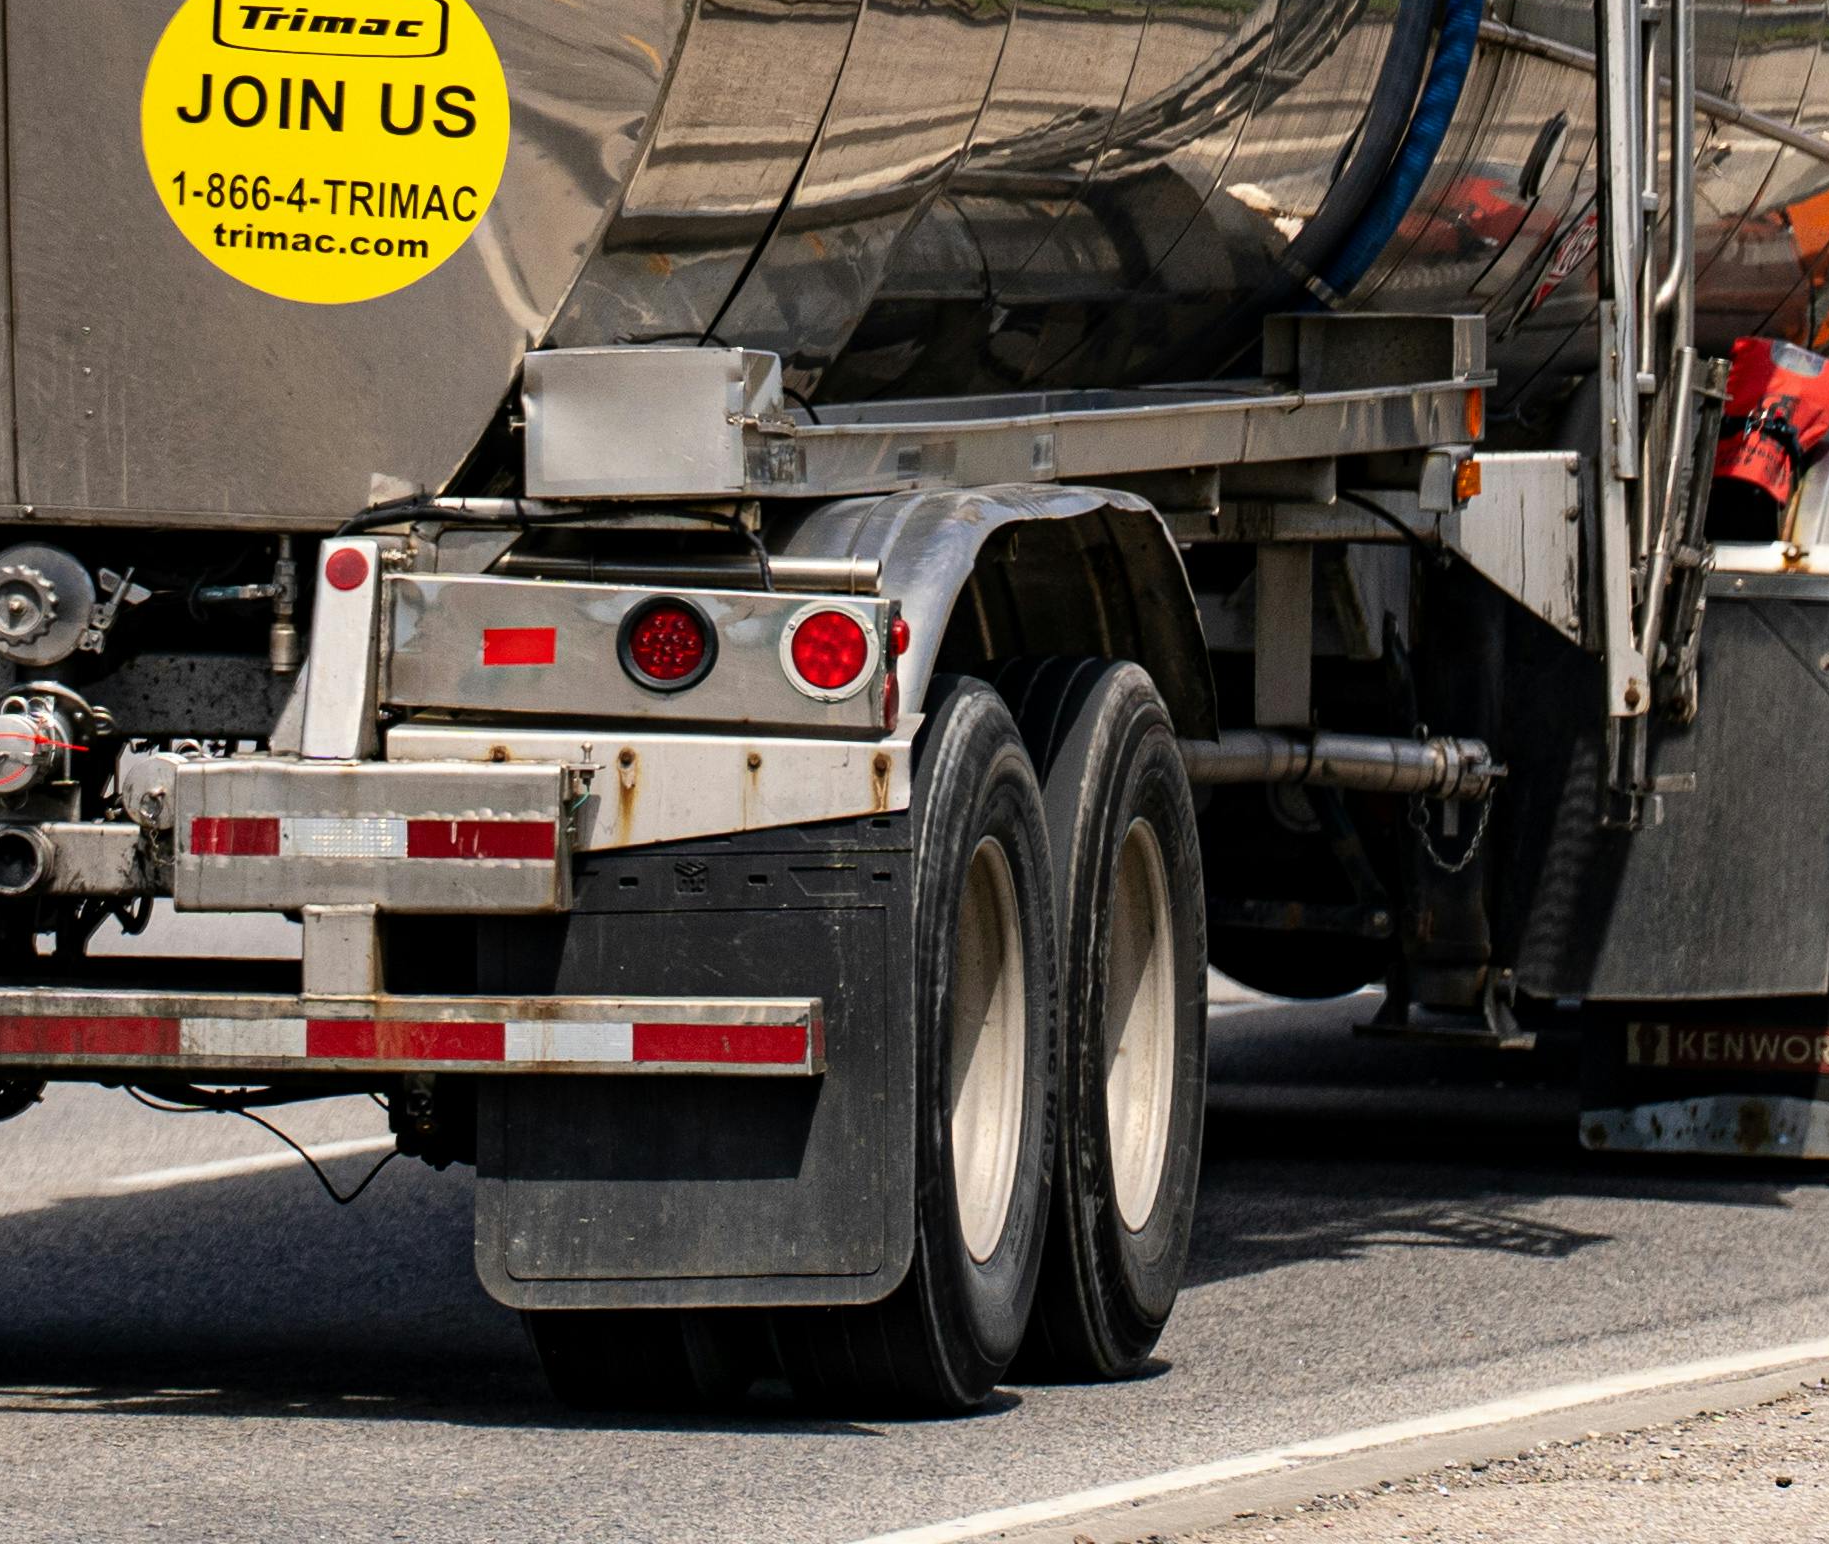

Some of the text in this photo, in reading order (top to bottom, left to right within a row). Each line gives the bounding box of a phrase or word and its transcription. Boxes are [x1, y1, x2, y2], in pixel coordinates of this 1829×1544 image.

[238, 4, 424, 38] Trimac
[176, 73, 477, 138] JOIN US
[172, 170, 478, 222] 1-866-4-TRIMAC
[213, 222, 429, 258] trimac.com
